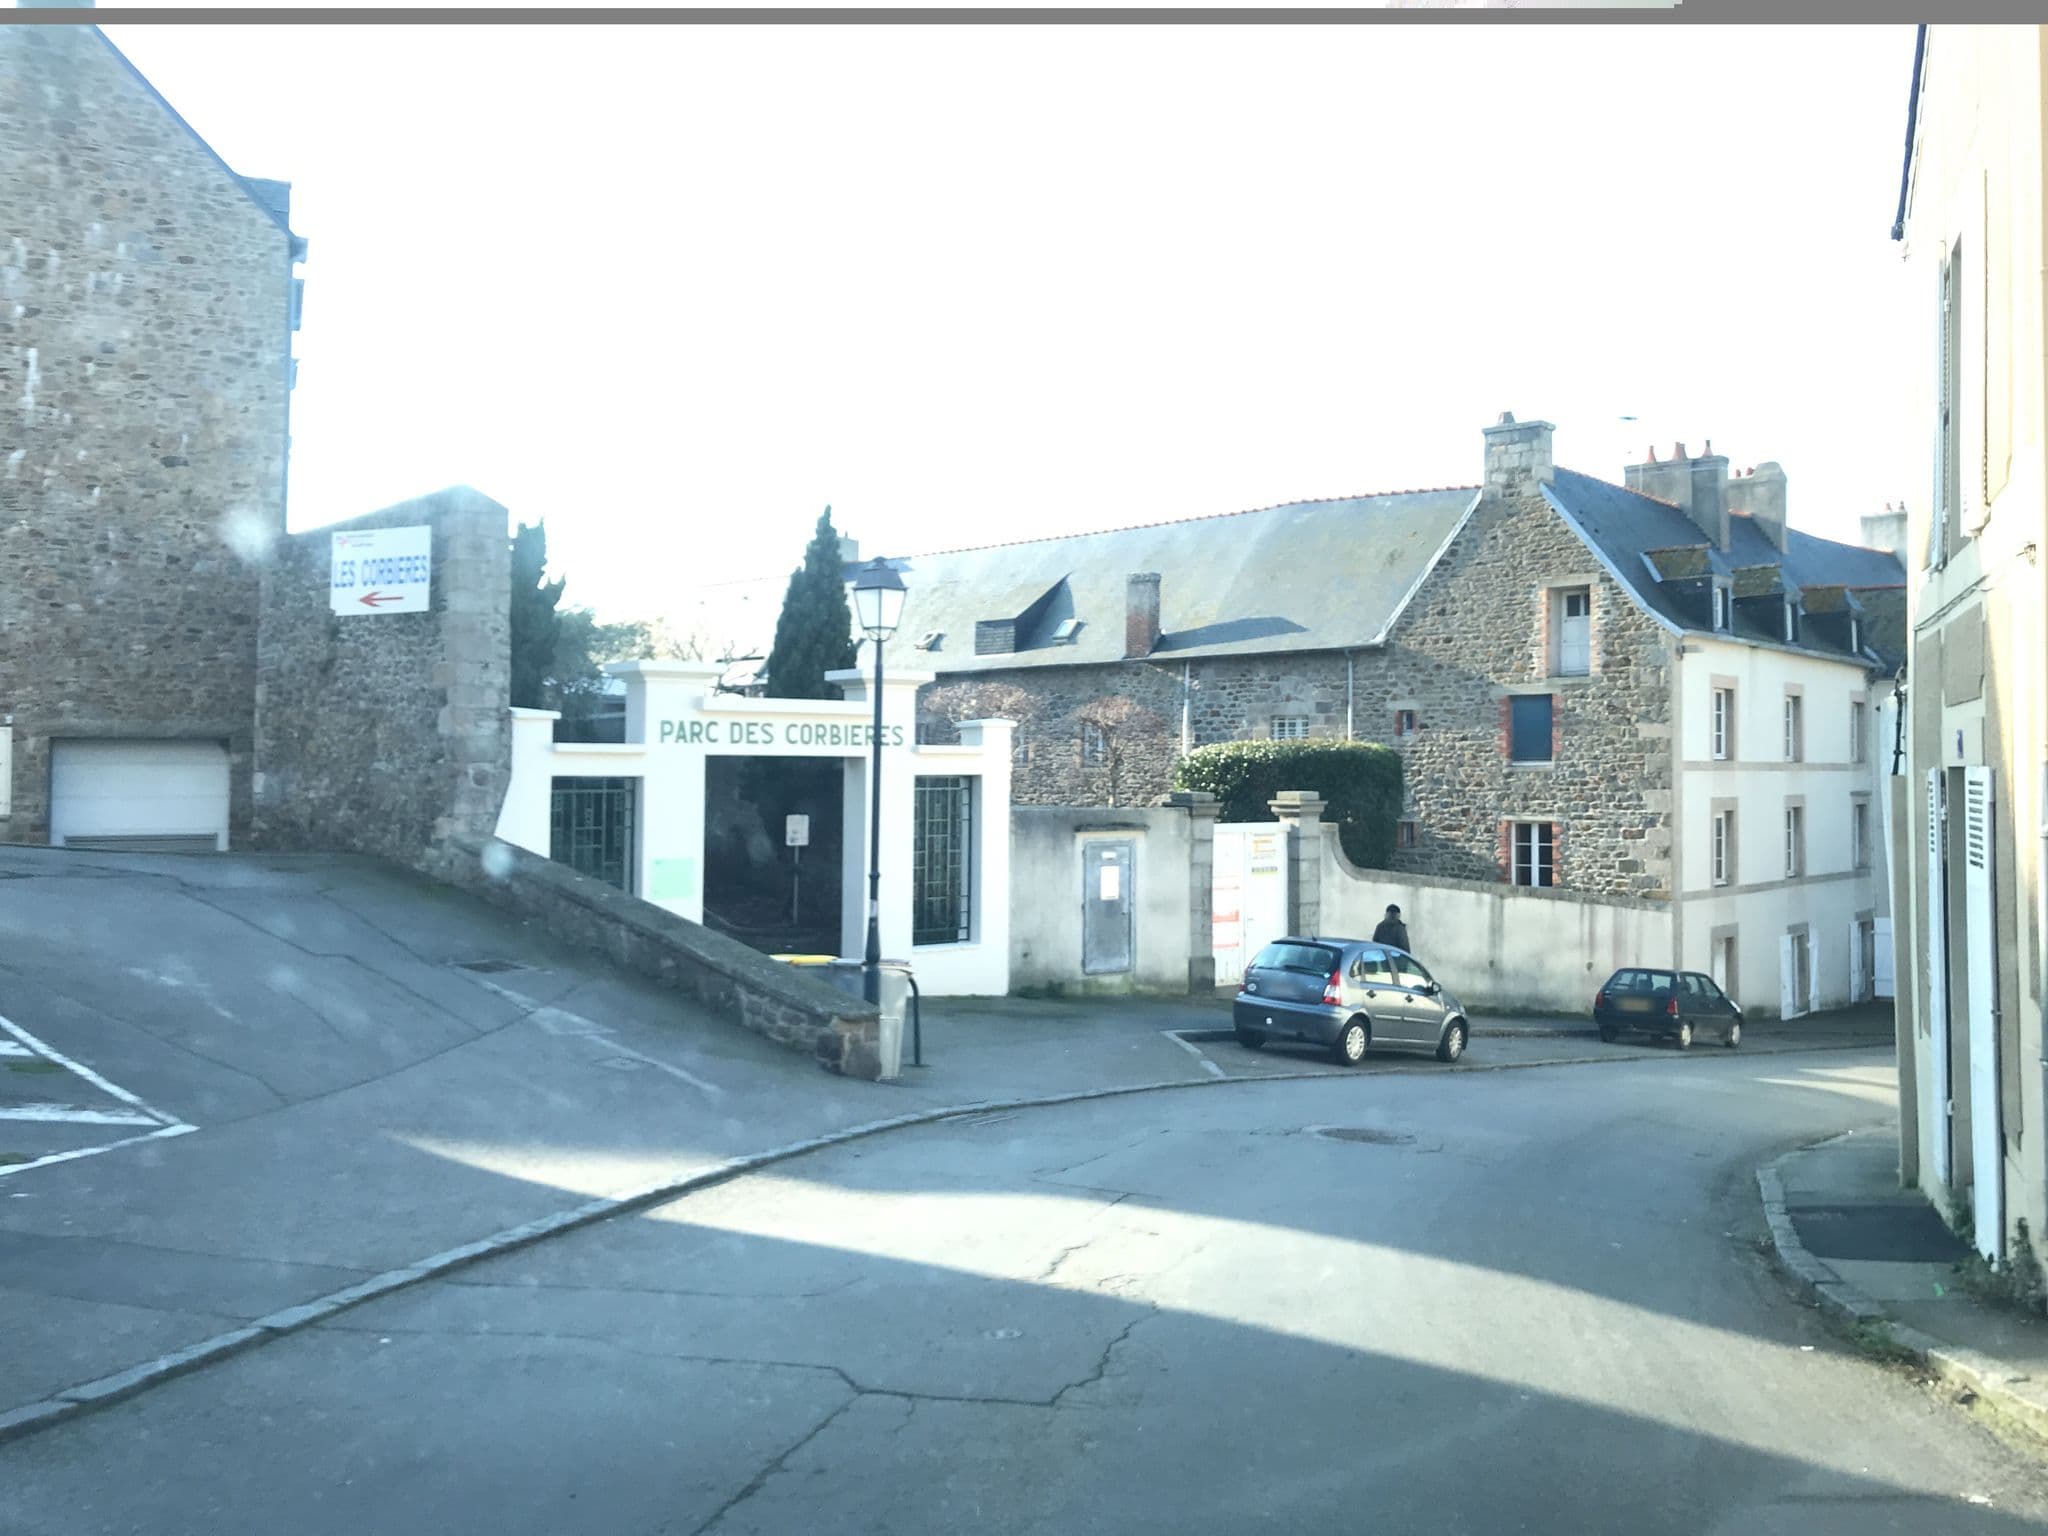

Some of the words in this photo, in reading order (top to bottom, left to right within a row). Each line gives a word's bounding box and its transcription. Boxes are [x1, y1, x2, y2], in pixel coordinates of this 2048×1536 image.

[334, 560, 355, 588] LES
[660, 720, 719, 744] PARC
[730, 722, 774, 745] DES
[785, 723, 904, 747] CORBIERES
